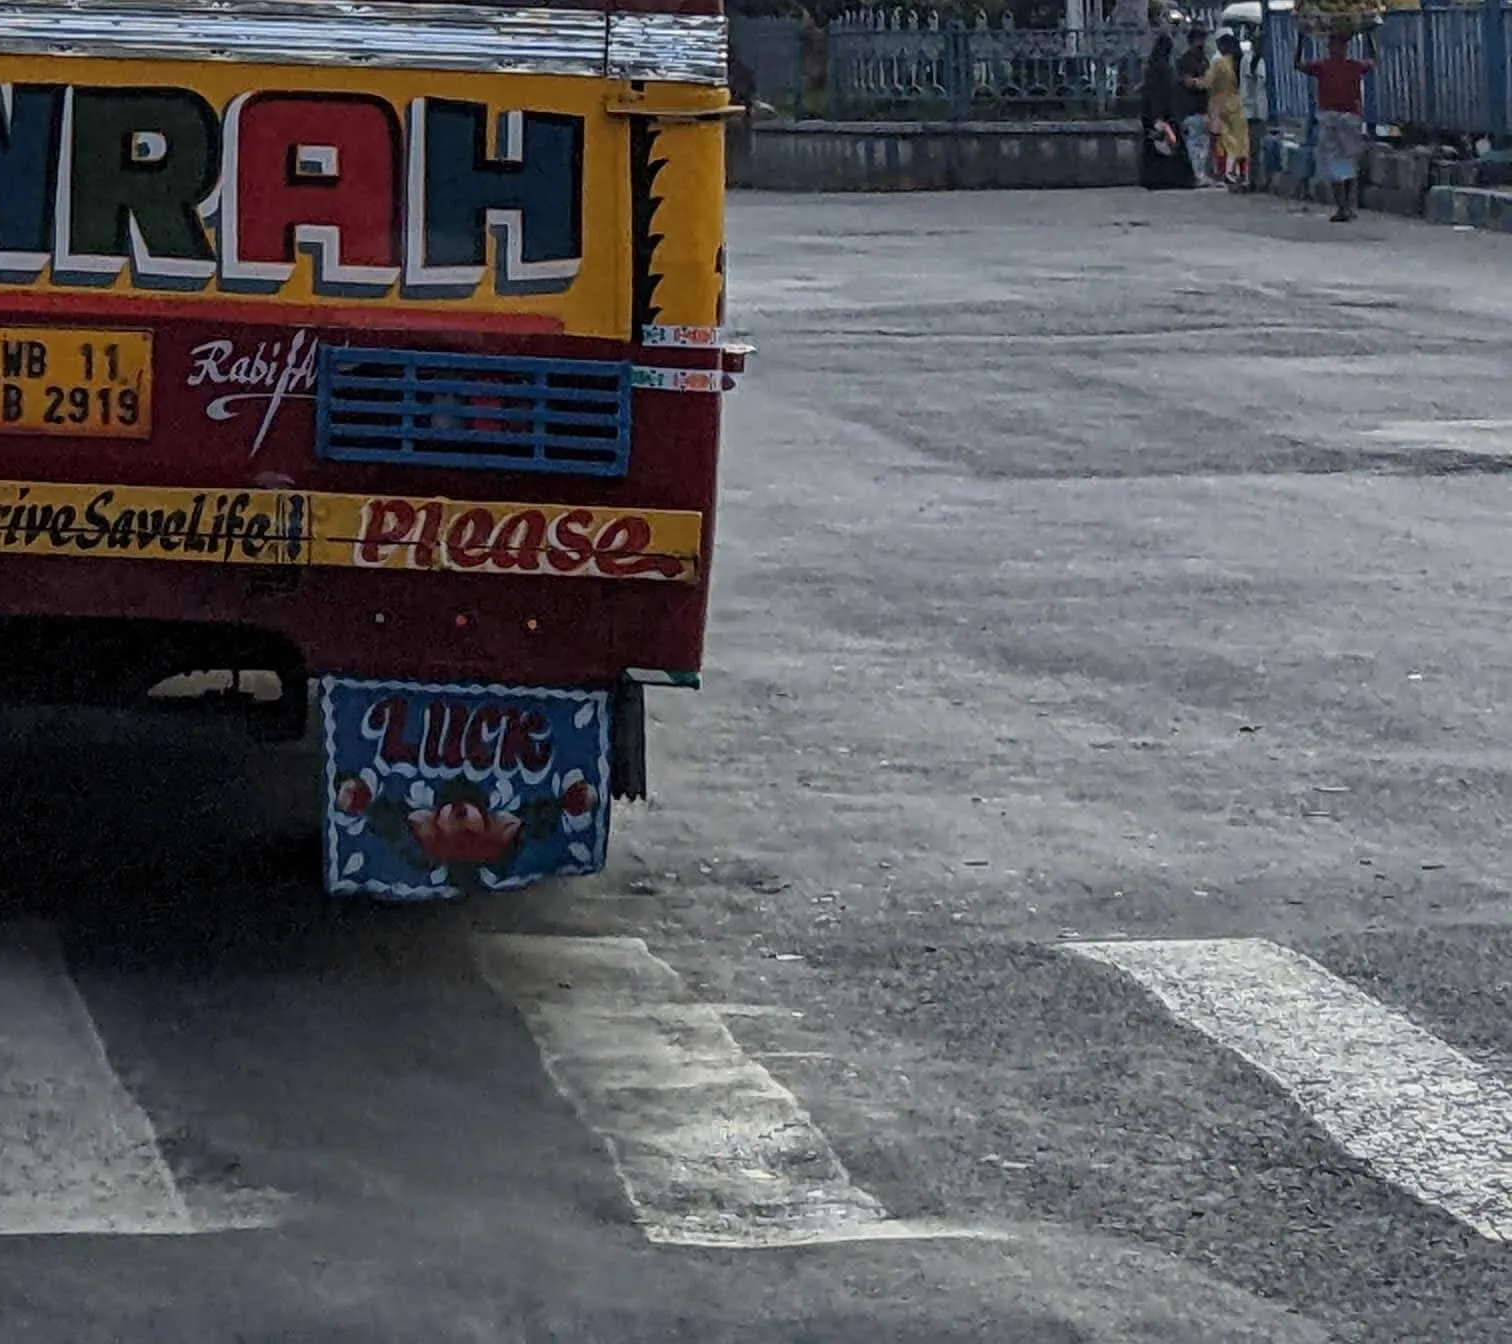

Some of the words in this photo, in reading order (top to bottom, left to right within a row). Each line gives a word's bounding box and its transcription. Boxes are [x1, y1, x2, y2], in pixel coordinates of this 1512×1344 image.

[2, 341, 47, 379] WB
[79, 343, 119, 381] 11
[2, 383, 23, 422] B
[43, 385, 139, 425] 2919
[354, 498, 687, 580] Please
